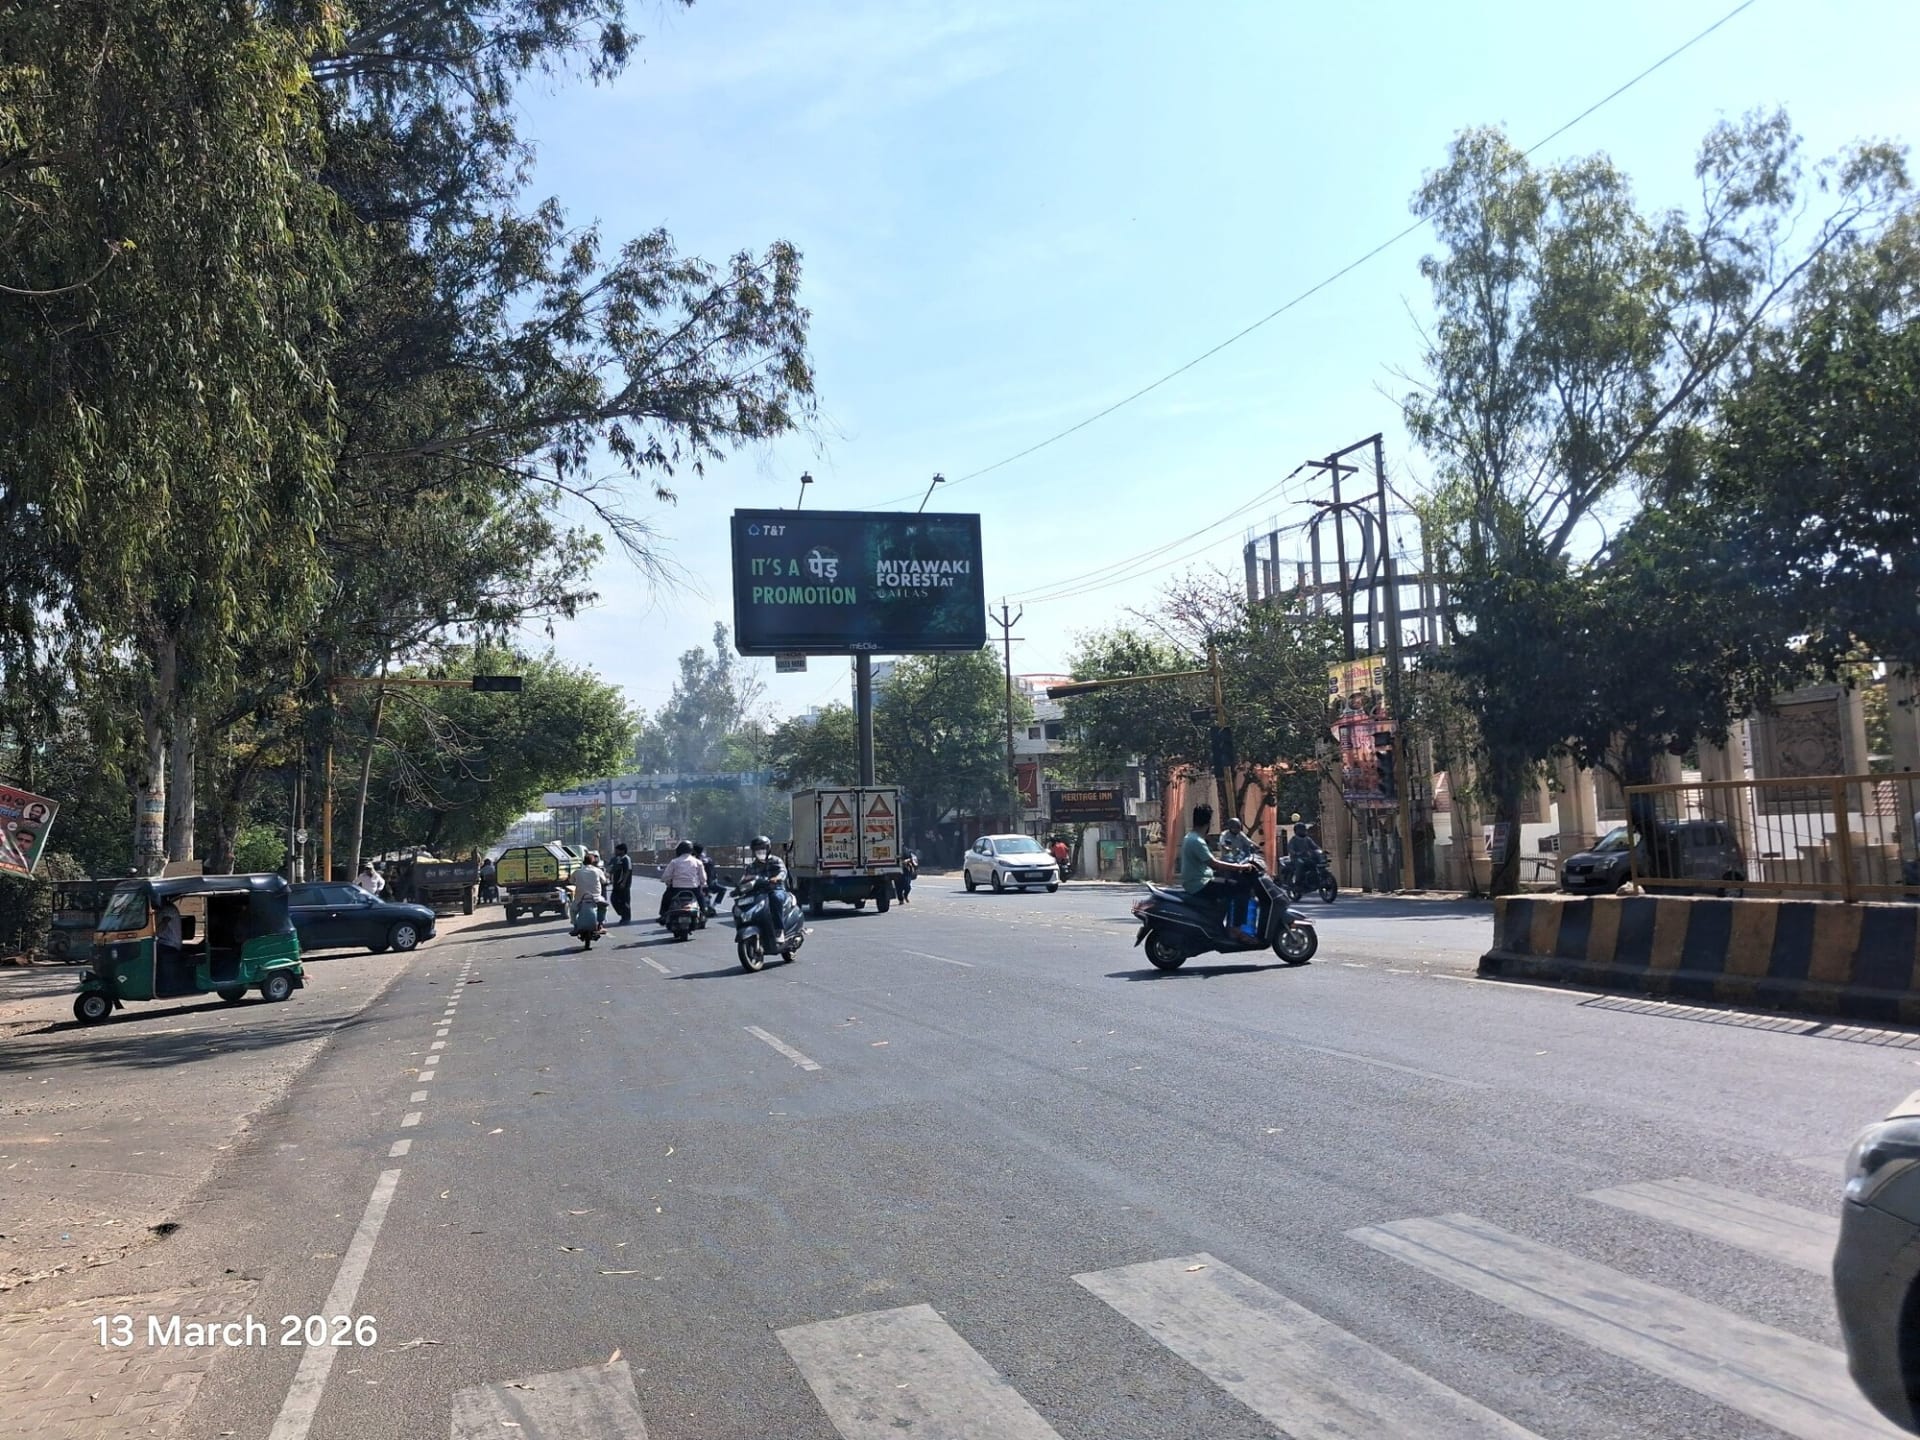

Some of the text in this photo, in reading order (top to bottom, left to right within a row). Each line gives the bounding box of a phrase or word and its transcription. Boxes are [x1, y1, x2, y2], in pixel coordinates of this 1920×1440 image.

[762, 525, 786, 536] T&T
[751, 549, 839, 584] IT'S A पेड़
[876, 559, 971, 574] MIYAWAKI
[876, 573, 955, 587] FOREST AT
[752, 585, 857, 605] PROMOTION
[1098, 791, 1113, 801] INN
